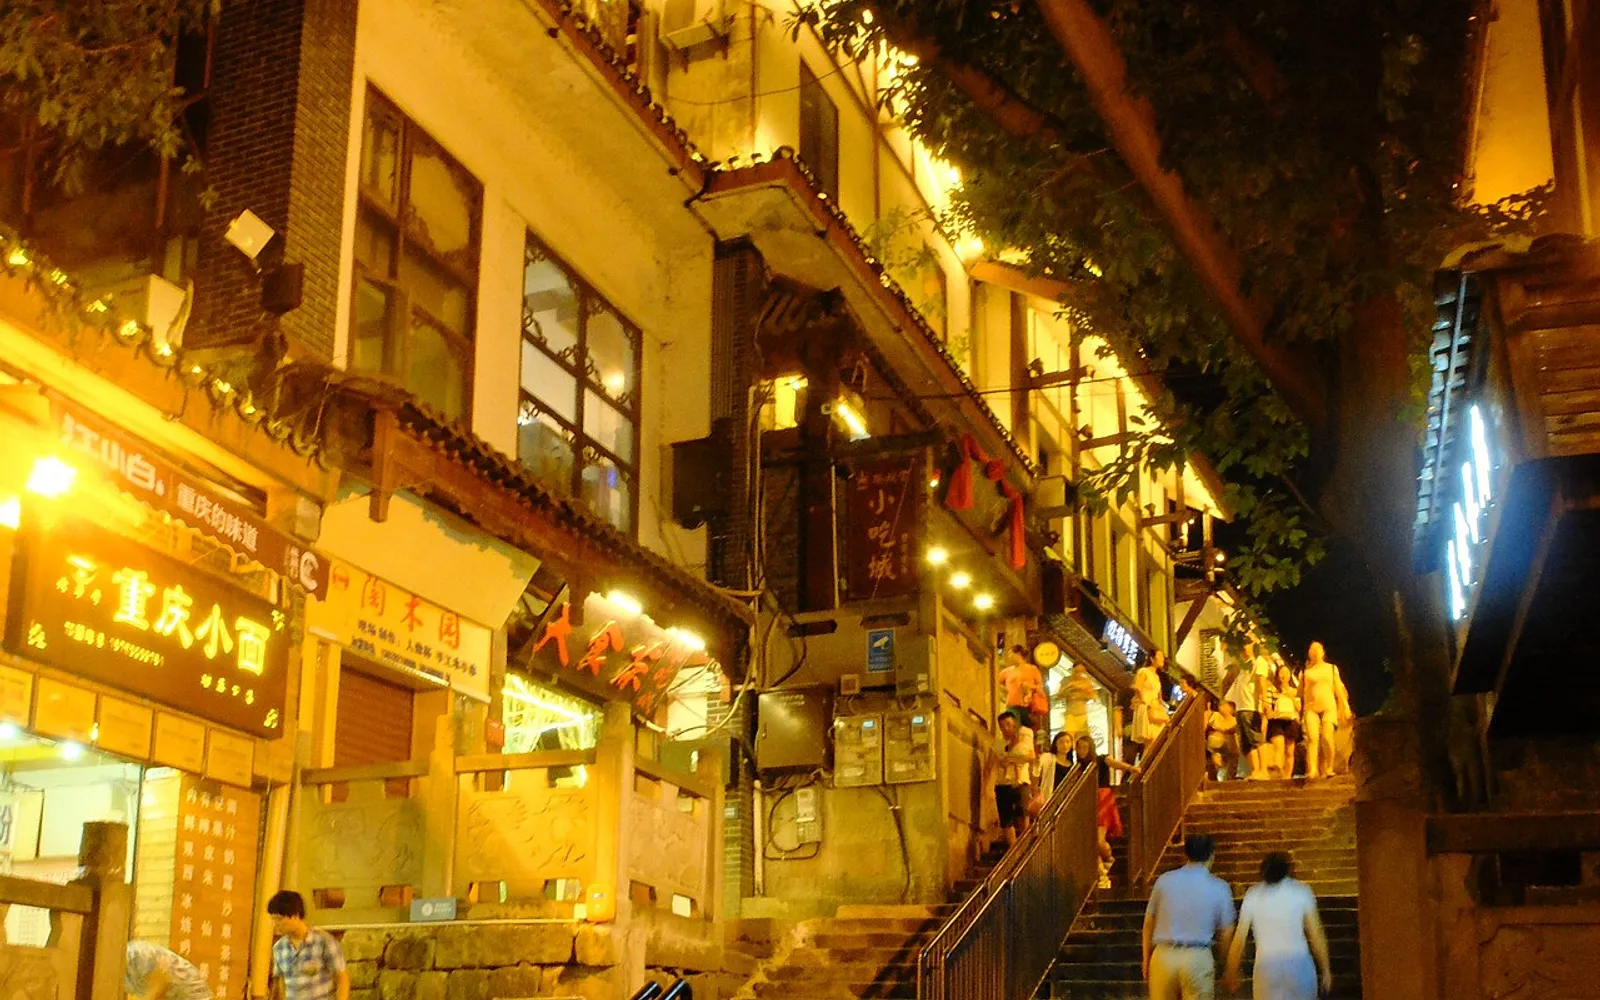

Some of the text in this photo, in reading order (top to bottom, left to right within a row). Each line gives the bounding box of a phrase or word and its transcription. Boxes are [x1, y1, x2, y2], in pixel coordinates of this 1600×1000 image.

[177, 483, 258, 552] 重庆的味道
[112, 567, 270, 676] 重庆小面
